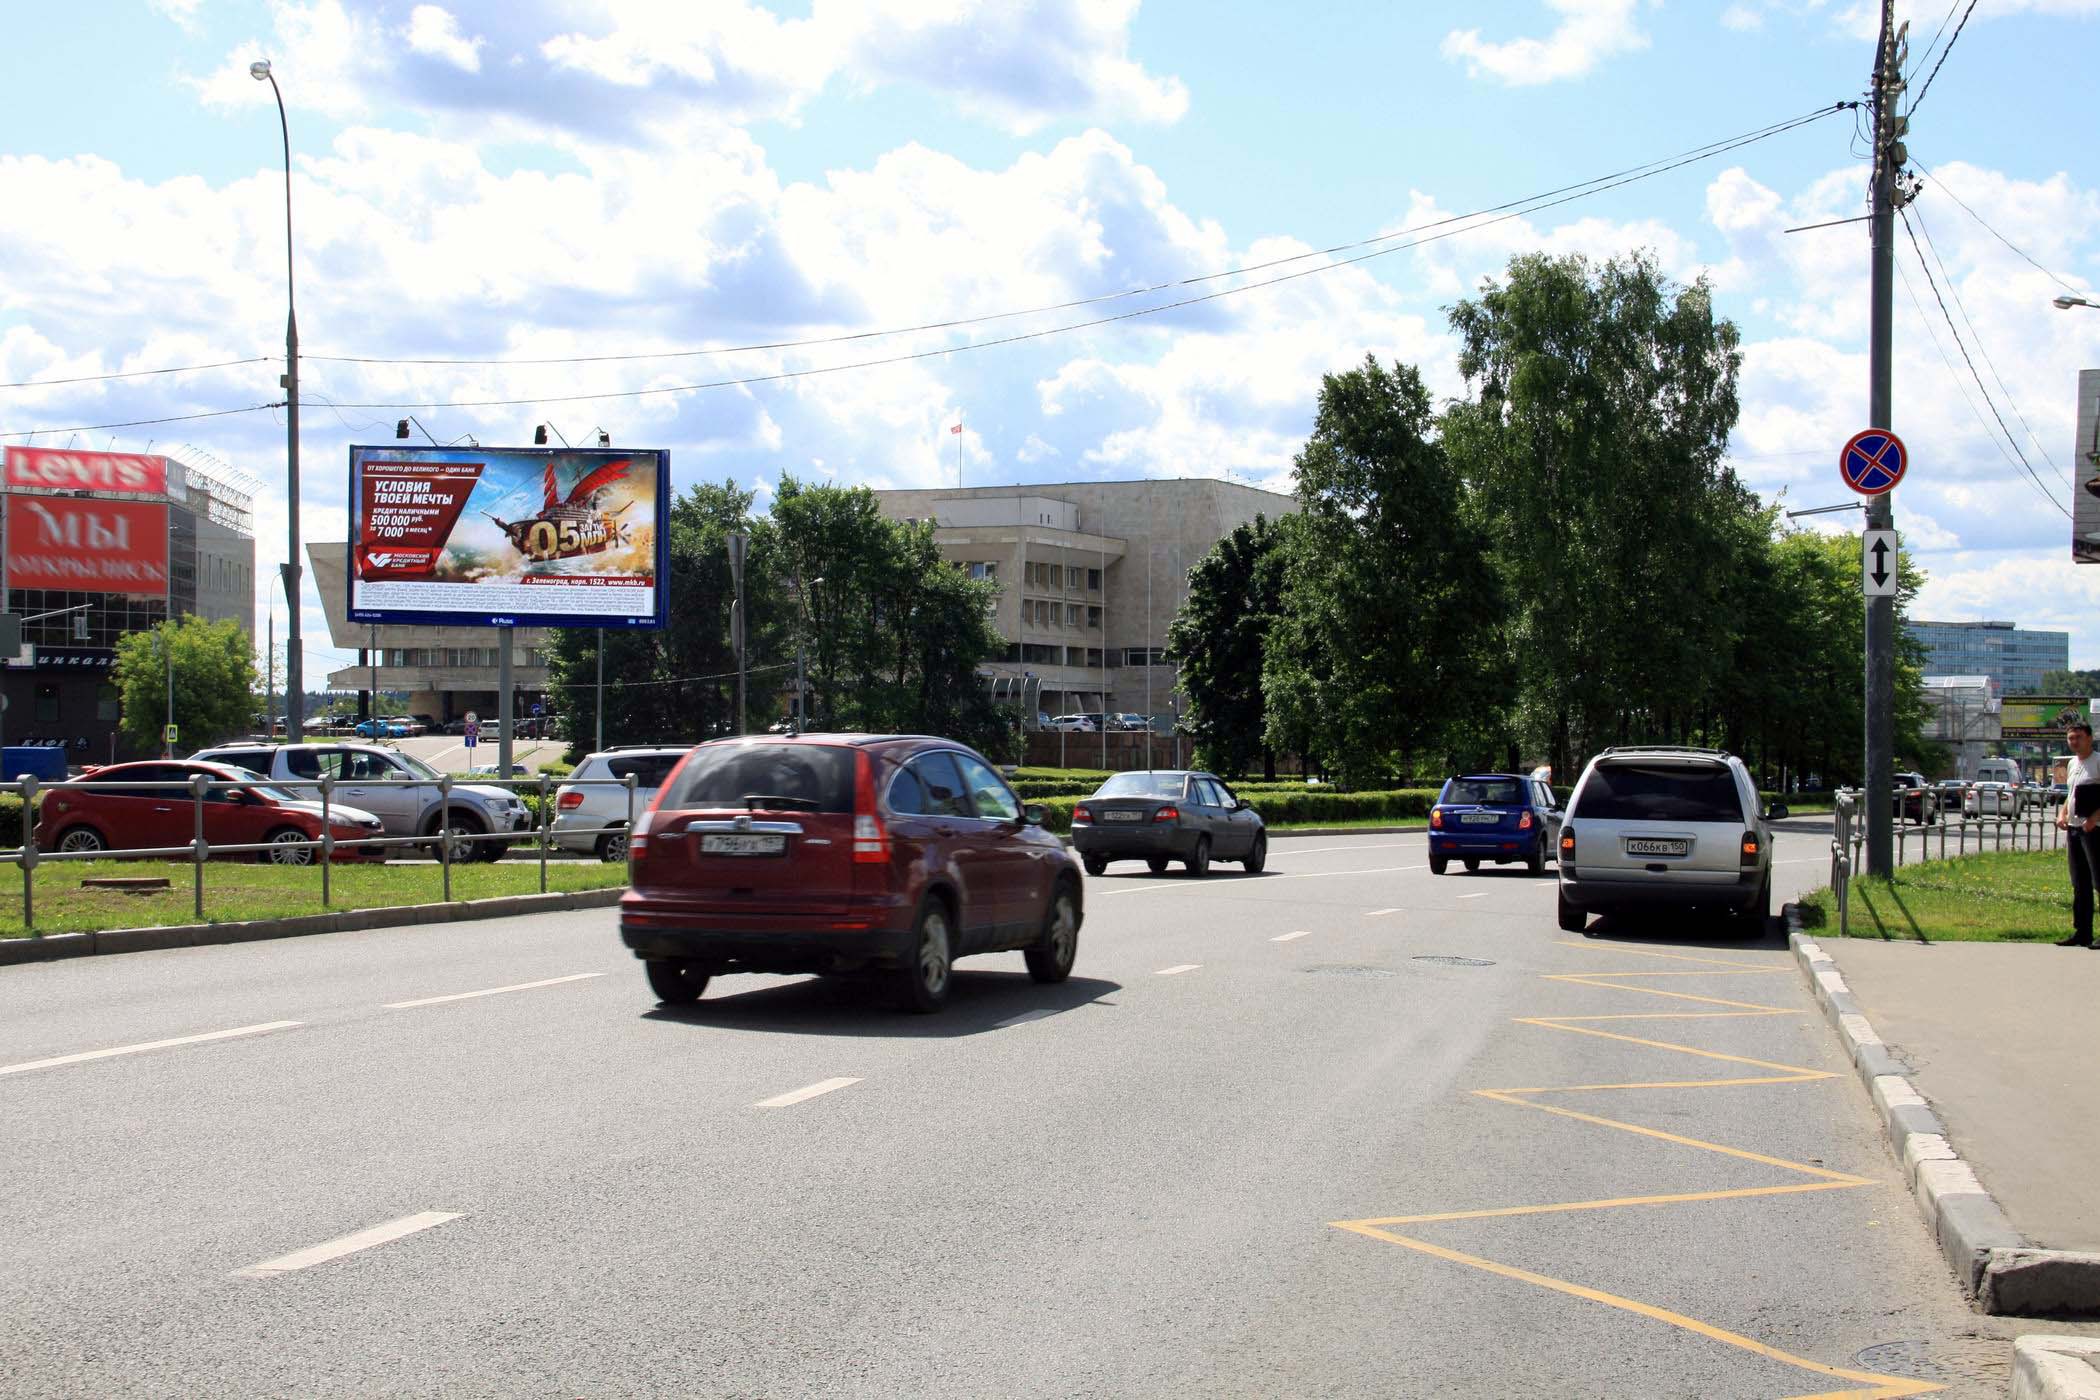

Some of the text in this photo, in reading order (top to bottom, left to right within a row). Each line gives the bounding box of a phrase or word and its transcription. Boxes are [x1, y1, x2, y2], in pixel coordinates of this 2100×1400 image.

[375, 481, 431, 493] УСЛОВИЯ
[374, 492, 454, 505] ТВОЕЙ МЕЧТЫ
[398, 508, 440, 516] НАЛИЧНЫМИ
[370, 515, 389, 526] 500
[390, 515, 411, 526] 000
[377, 526, 384, 537] 7
[384, 527, 404, 537] 000
[590, 578, 606, 586] 1522,
